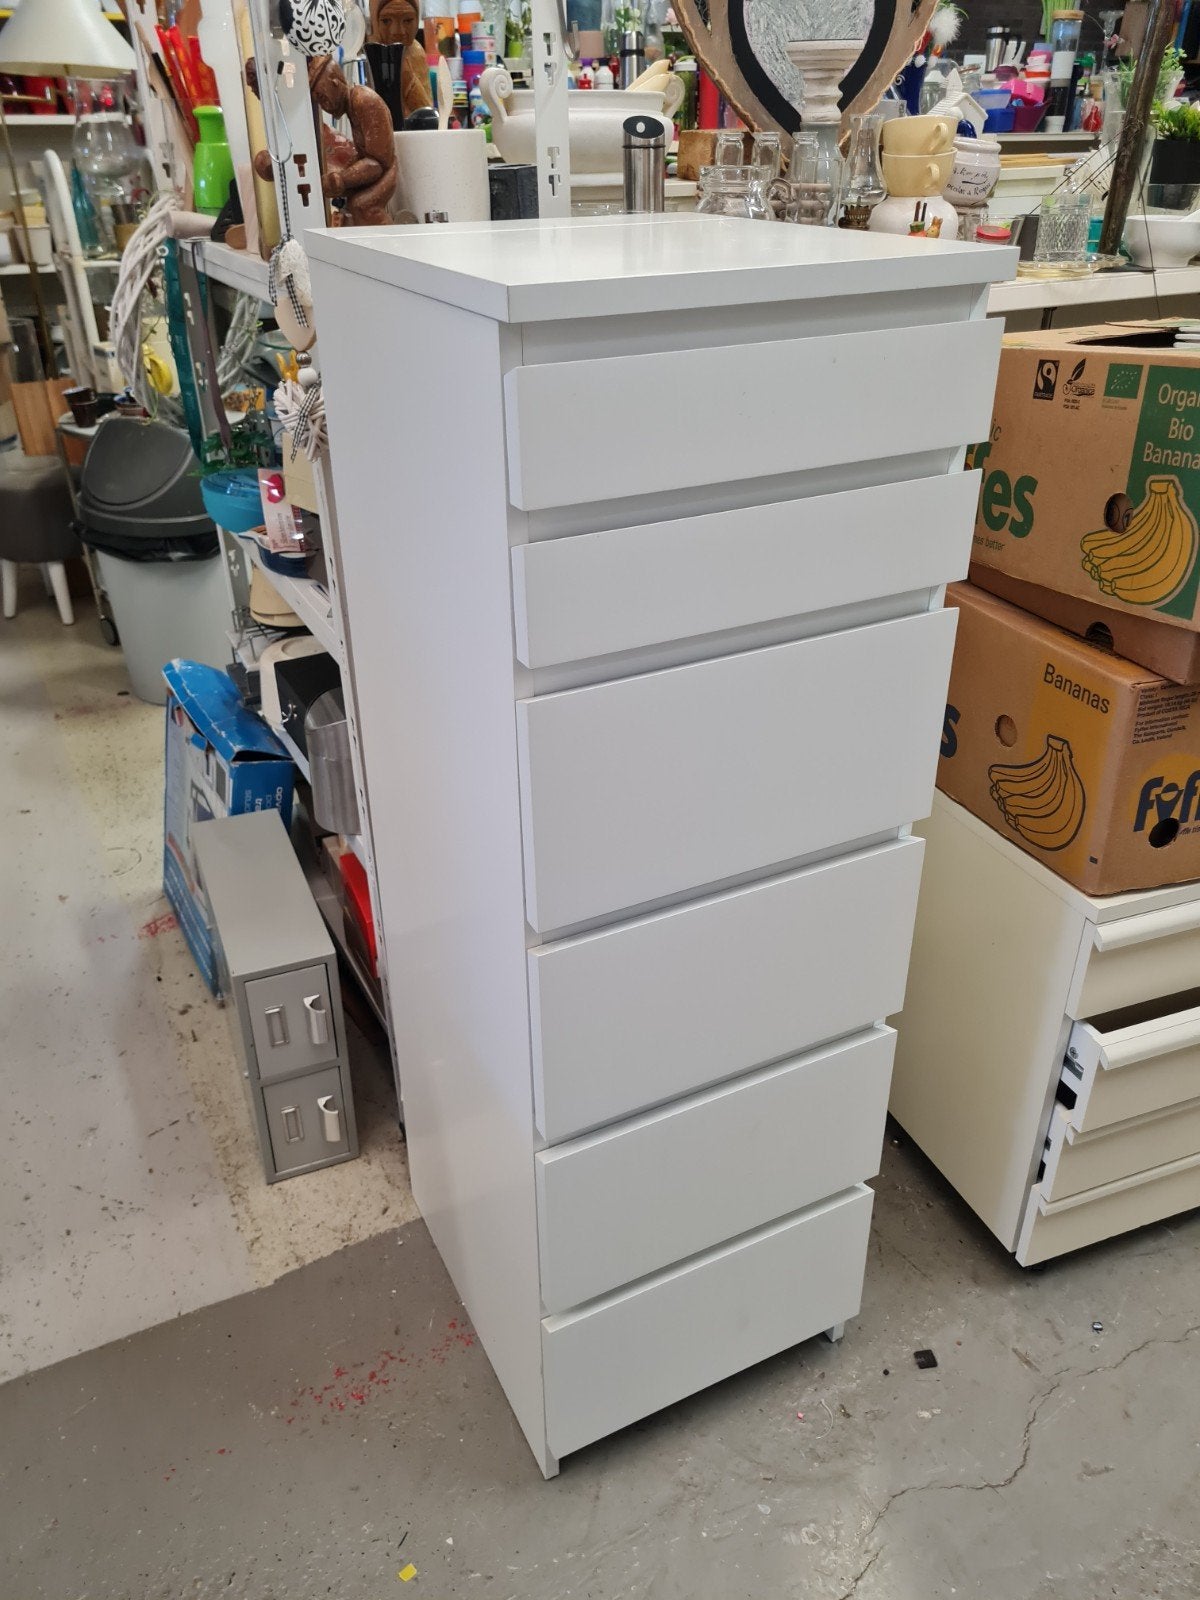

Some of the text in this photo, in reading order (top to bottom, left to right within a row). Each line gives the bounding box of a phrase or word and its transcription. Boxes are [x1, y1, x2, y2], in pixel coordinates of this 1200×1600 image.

[1158, 383, 1200, 411] Orga
[1168, 417, 1194, 441] Bio
[1044, 662, 1110, 714] Bananas
